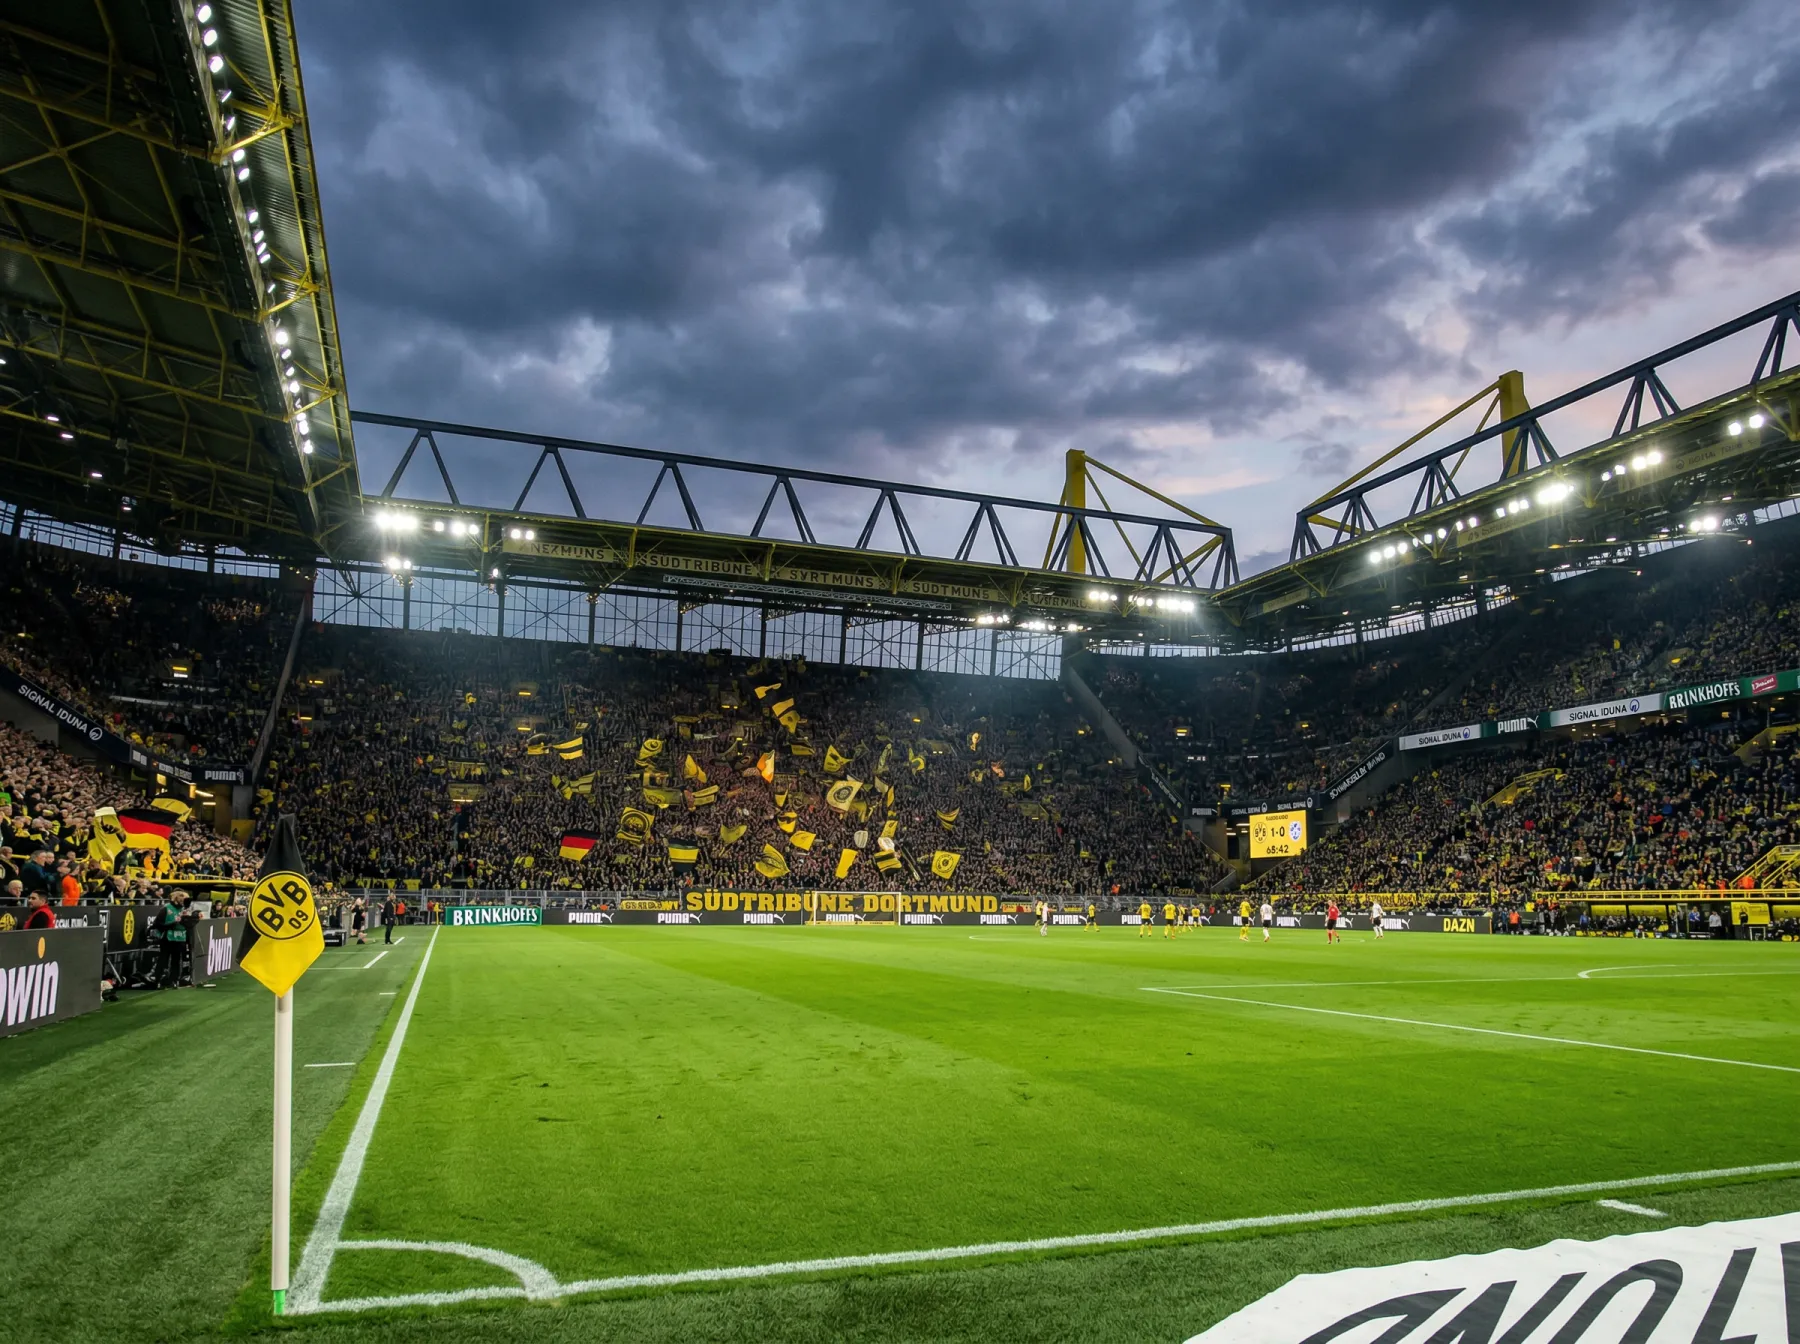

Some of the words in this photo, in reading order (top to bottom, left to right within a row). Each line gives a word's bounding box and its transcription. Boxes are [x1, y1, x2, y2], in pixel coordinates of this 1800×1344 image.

[18, 684, 55, 713] SIGNAL
[56, 707, 88, 733] IDUNA
[1569, 708, 1599, 722] SIGNAL
[1601, 705, 1628, 717] IDUNA
[257, 880, 307, 933] BVB
[686, 888, 854, 912] SÜDTRIBÜNE
[863, 894, 998, 913] DORTMUND
[288, 909, 309, 930] 09
[1443, 917, 1475, 933] DAZN
[207, 922, 233, 976] bwin
